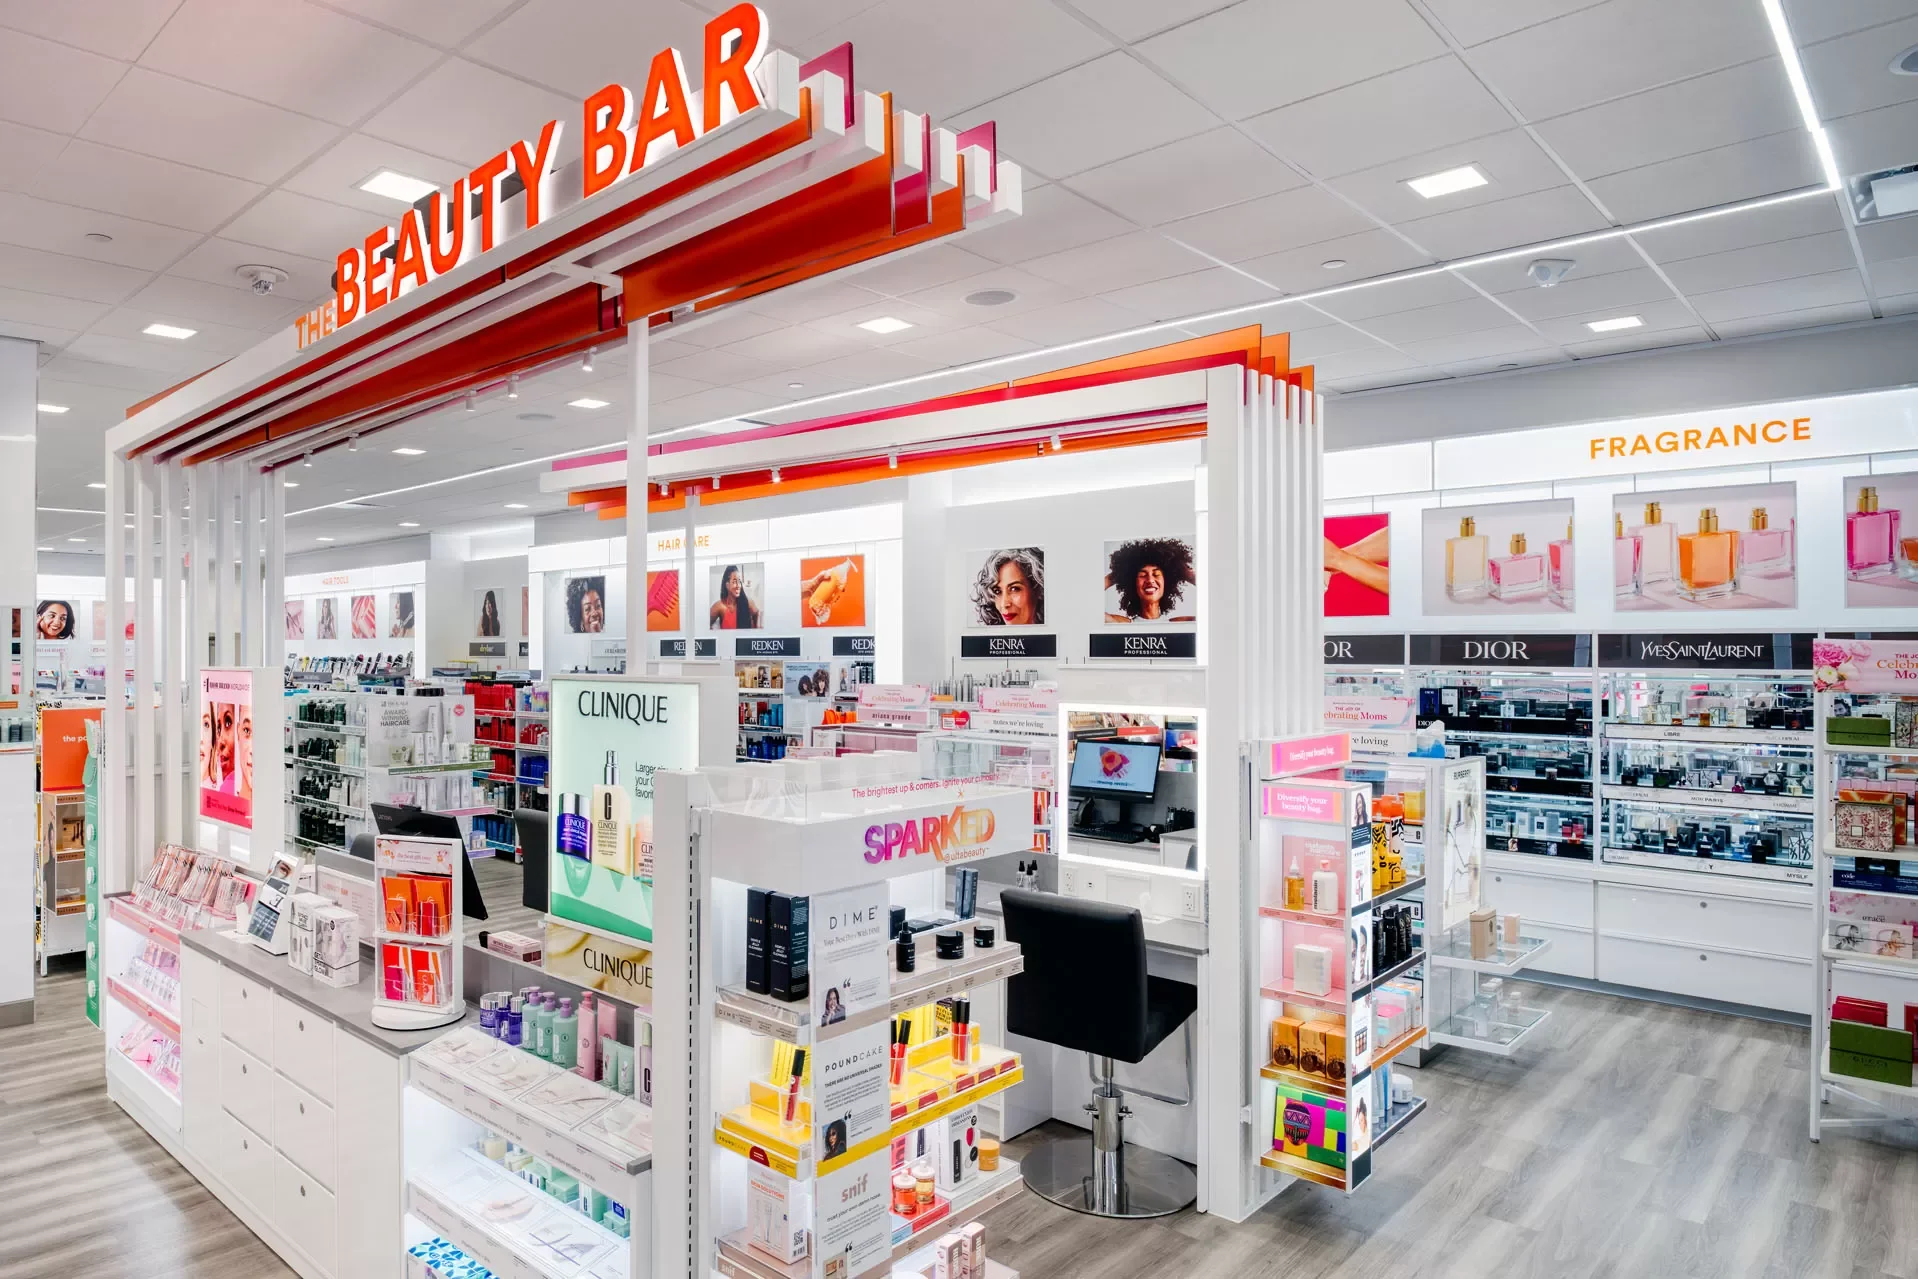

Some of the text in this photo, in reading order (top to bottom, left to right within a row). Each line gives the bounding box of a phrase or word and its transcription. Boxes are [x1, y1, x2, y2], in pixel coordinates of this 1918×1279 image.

[295, 2, 768, 350] THE BEAUTY BAR
[1590, 417, 1811, 460] FRAGRANCE
[657, 538, 681, 551] HAIR
[751, 640, 784, 651] REDKEN
[989, 638, 1024, 650] KENRA
[1124, 637, 1166, 650] KENRA
[1463, 640, 1530, 660] DIOR
[578, 690, 668, 726] CLINIQUE
[1360, 711, 1388, 720] Moms
[1361, 736, 1388, 747] loving
[635, 776, 649, 787] your
[852, 788, 866, 798] The
[867, 785, 899, 798] brightest
[899, 785, 908, 794] up
[909, 782, 915, 791] &
[960, 776, 975, 786] your
[1276, 792, 1328, 806] Diversify your
[1281, 801, 1307, 811] beauty
[565, 818, 586, 830] CLINIQUE
[864, 805, 995, 864] SPARKED
[773, 923, 788, 931] DIME
[583, 948, 652, 989] CLINIQUE
[825, 1045, 883, 1073] POUNDCAKE
[841, 1173, 868, 1203] snif
[721, 1263, 736, 1277] snif
